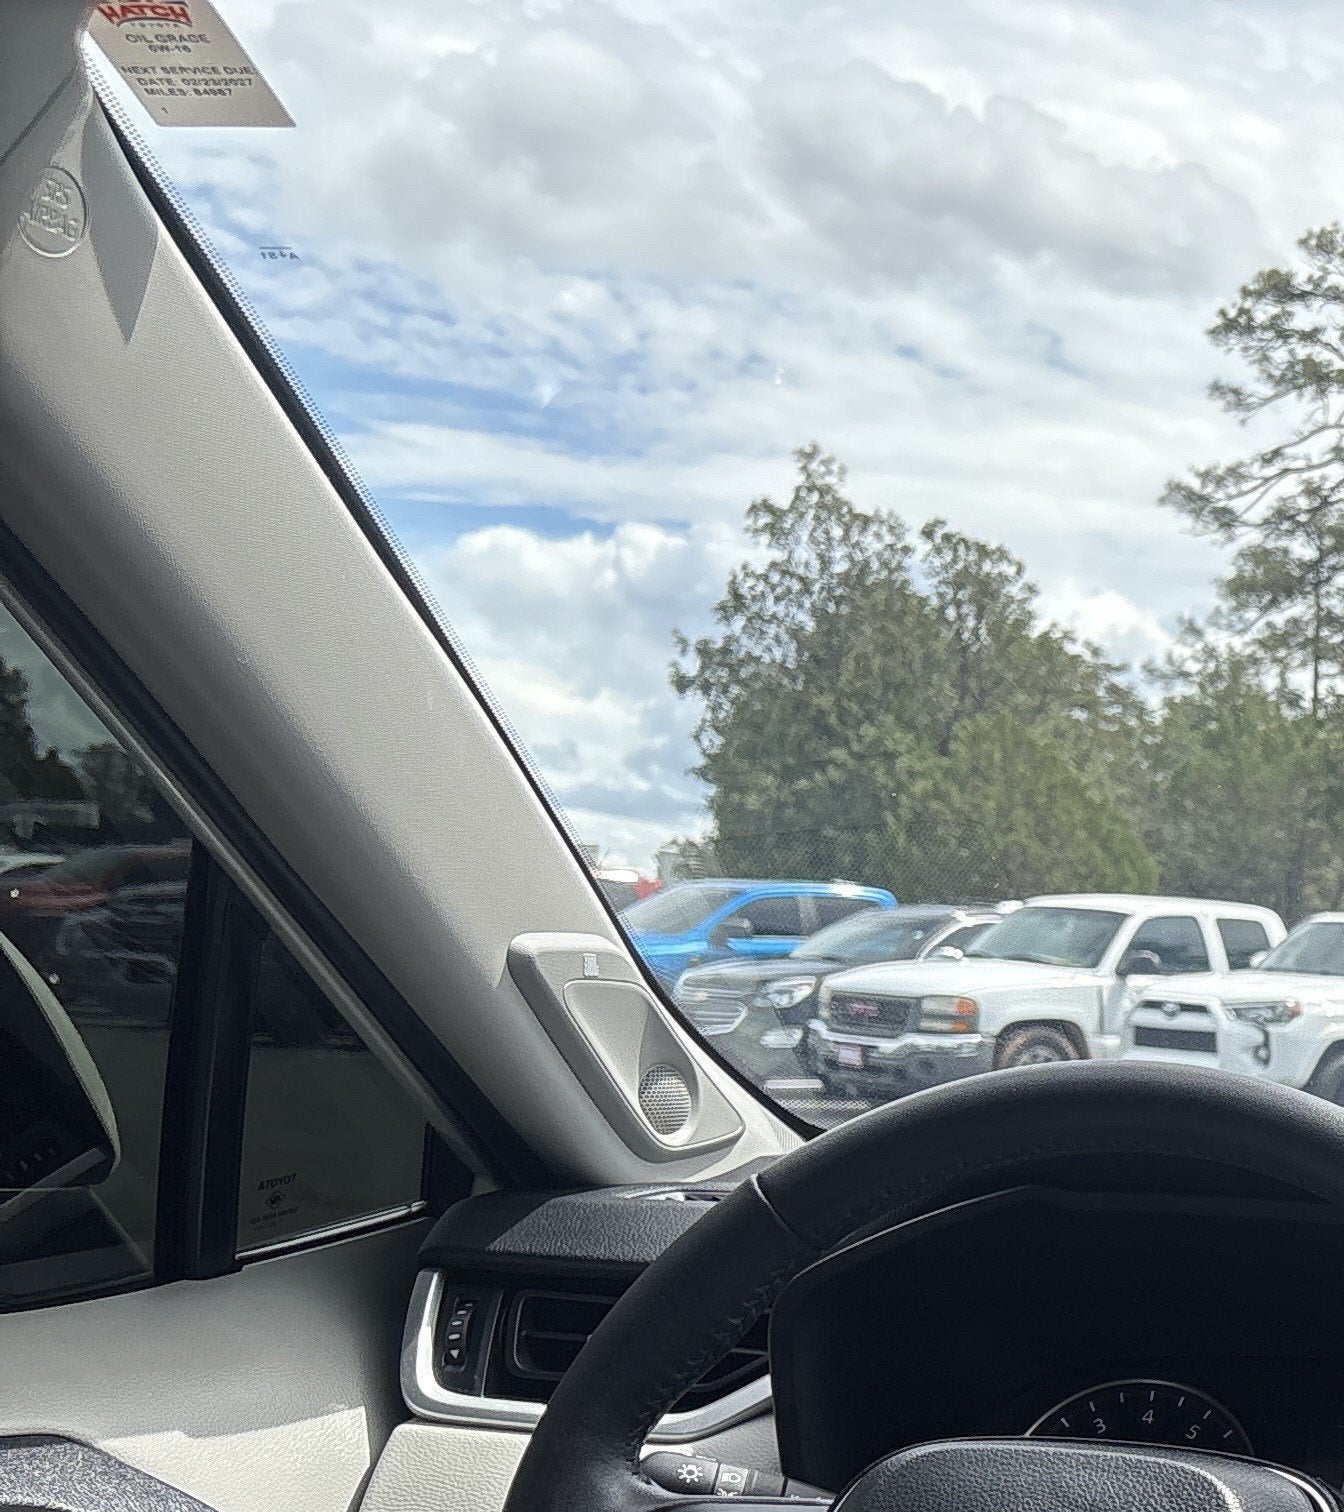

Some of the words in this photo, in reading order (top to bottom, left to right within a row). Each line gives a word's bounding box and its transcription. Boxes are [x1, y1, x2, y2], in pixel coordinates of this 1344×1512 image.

[98, 3, 192, 27] HATCH
[121, 66, 157, 75] NEXT
[160, 66, 222, 75] SERVICE
[1141, 1409, 1155, 1425] 4
[1092, 1417, 1107, 1435] 3
[1185, 1423, 1202, 1440] 5
